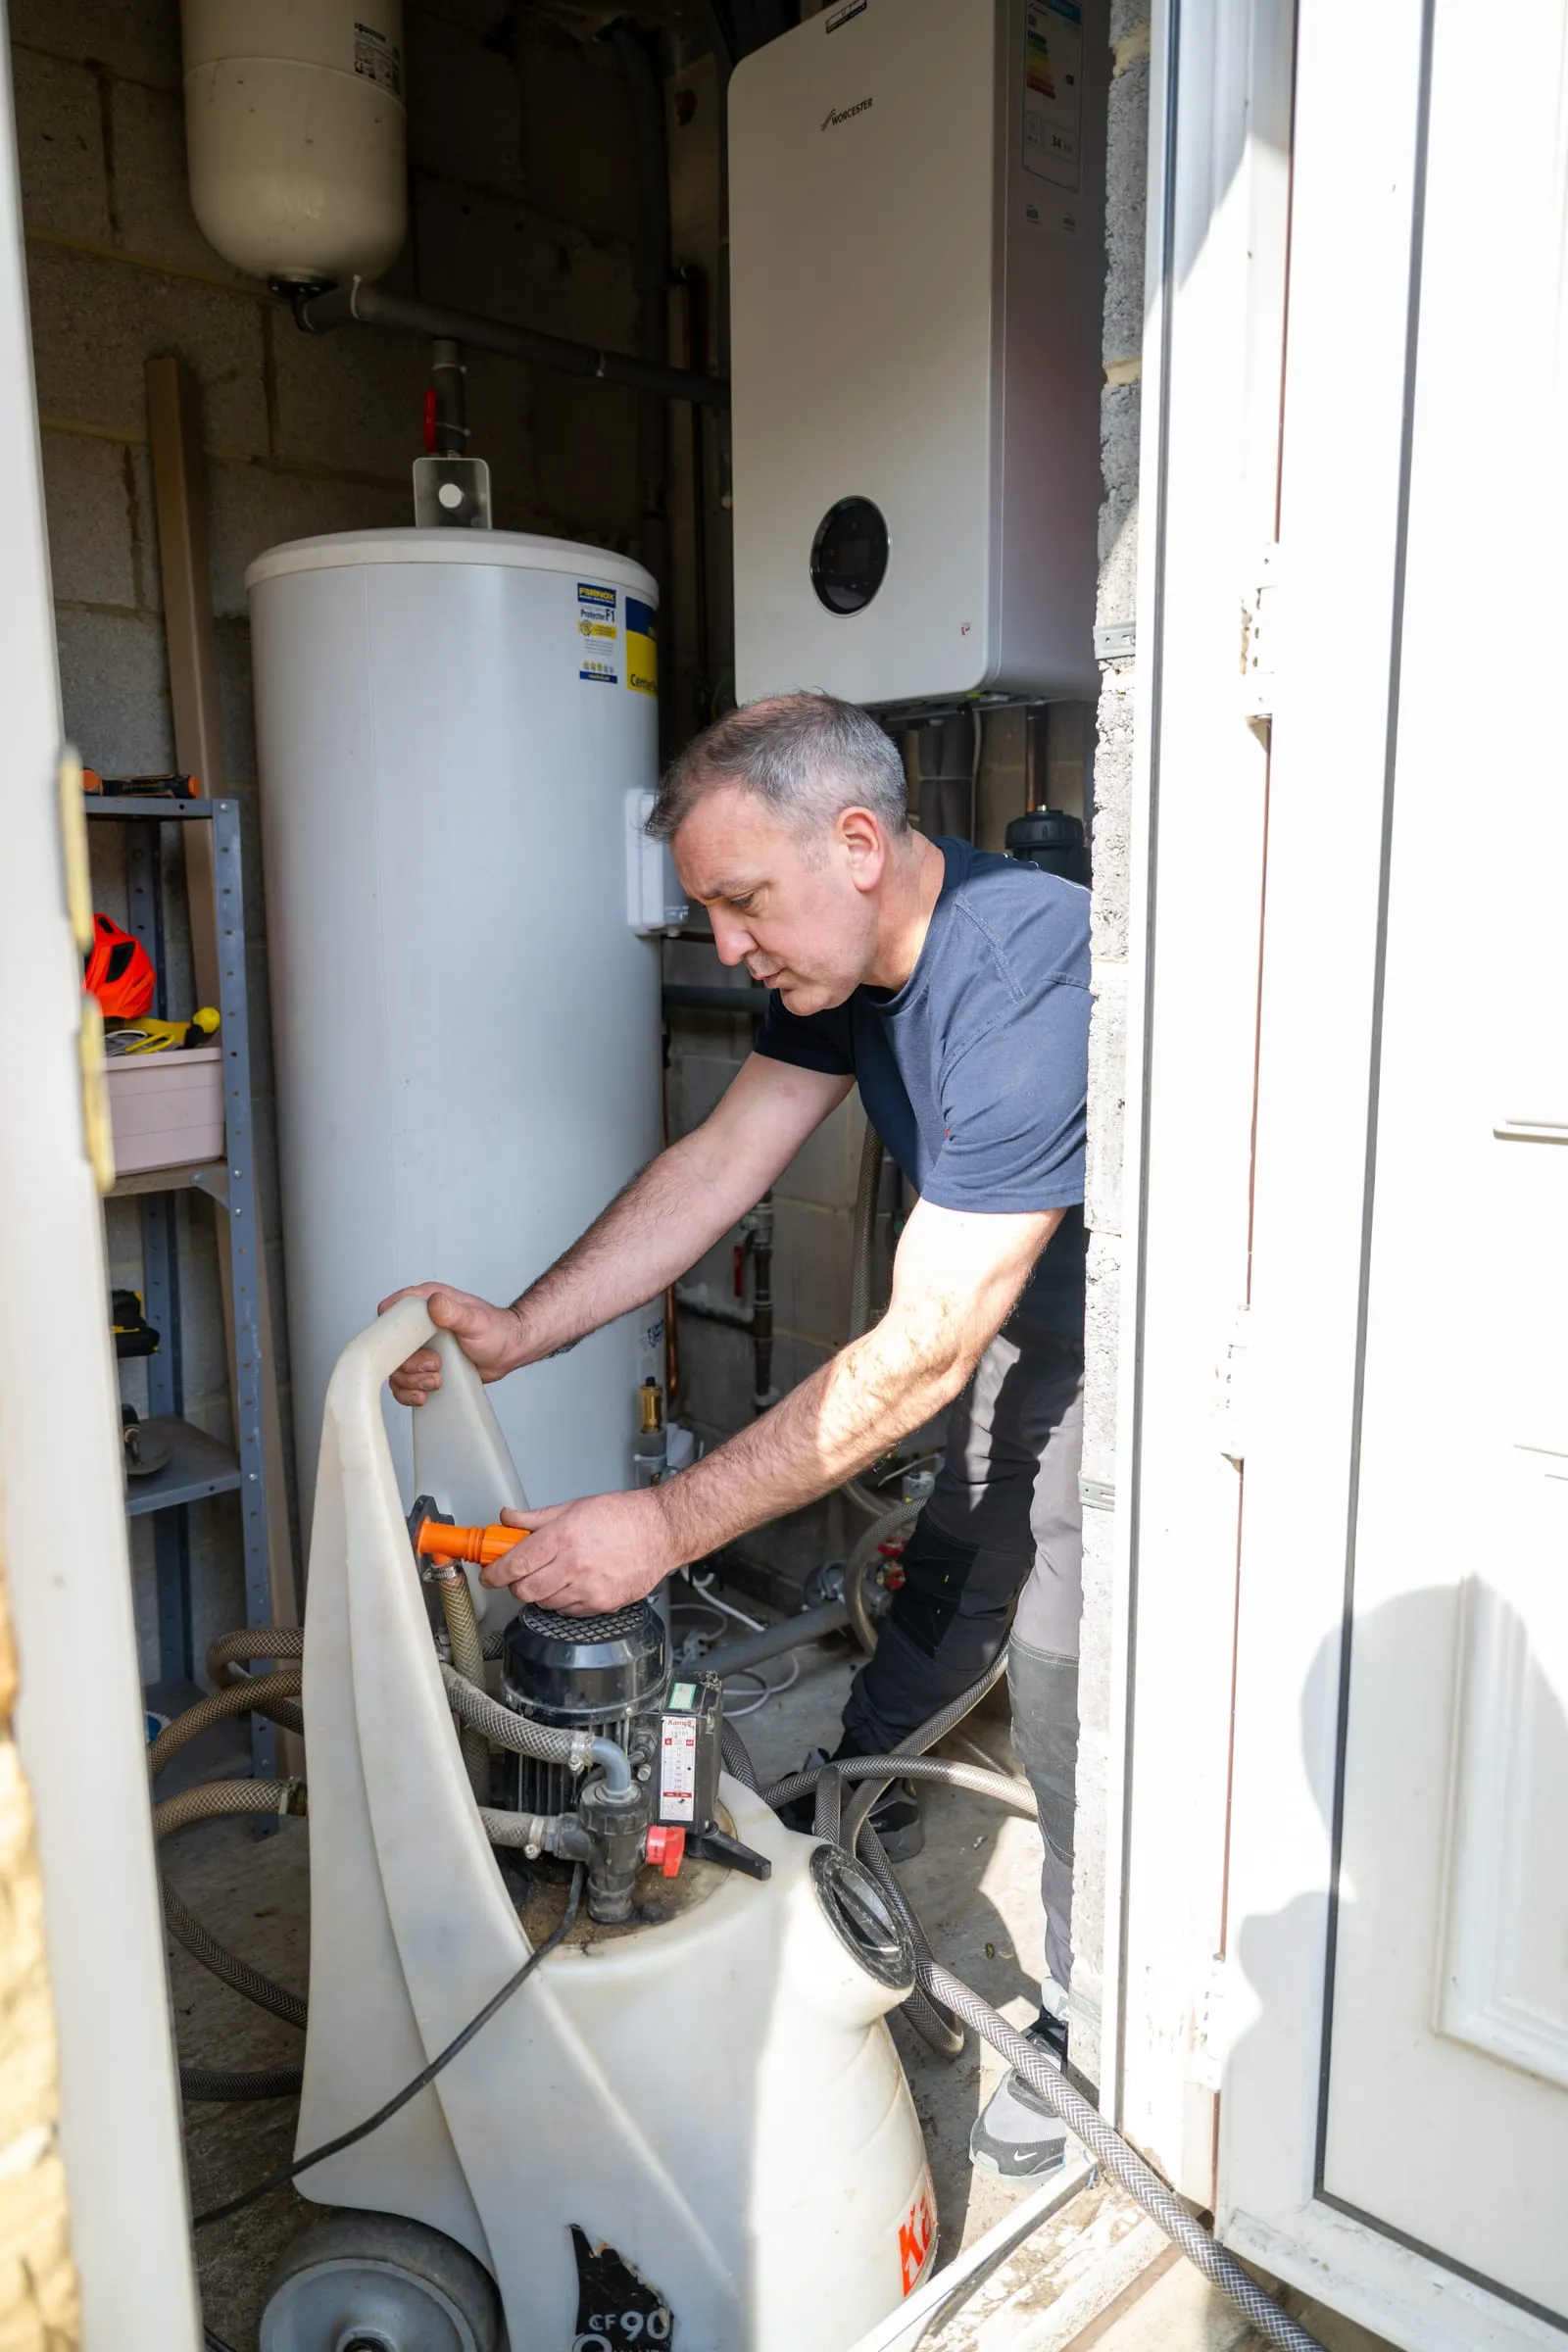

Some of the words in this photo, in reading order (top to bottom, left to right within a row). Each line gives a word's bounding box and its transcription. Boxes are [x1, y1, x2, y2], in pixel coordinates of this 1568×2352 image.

[832, 97, 873, 126] WORCESTER
[1051, 135, 1062, 150] 34
[578, 587, 615, 601] FERNOX
[606, 609, 615, 622] F1
